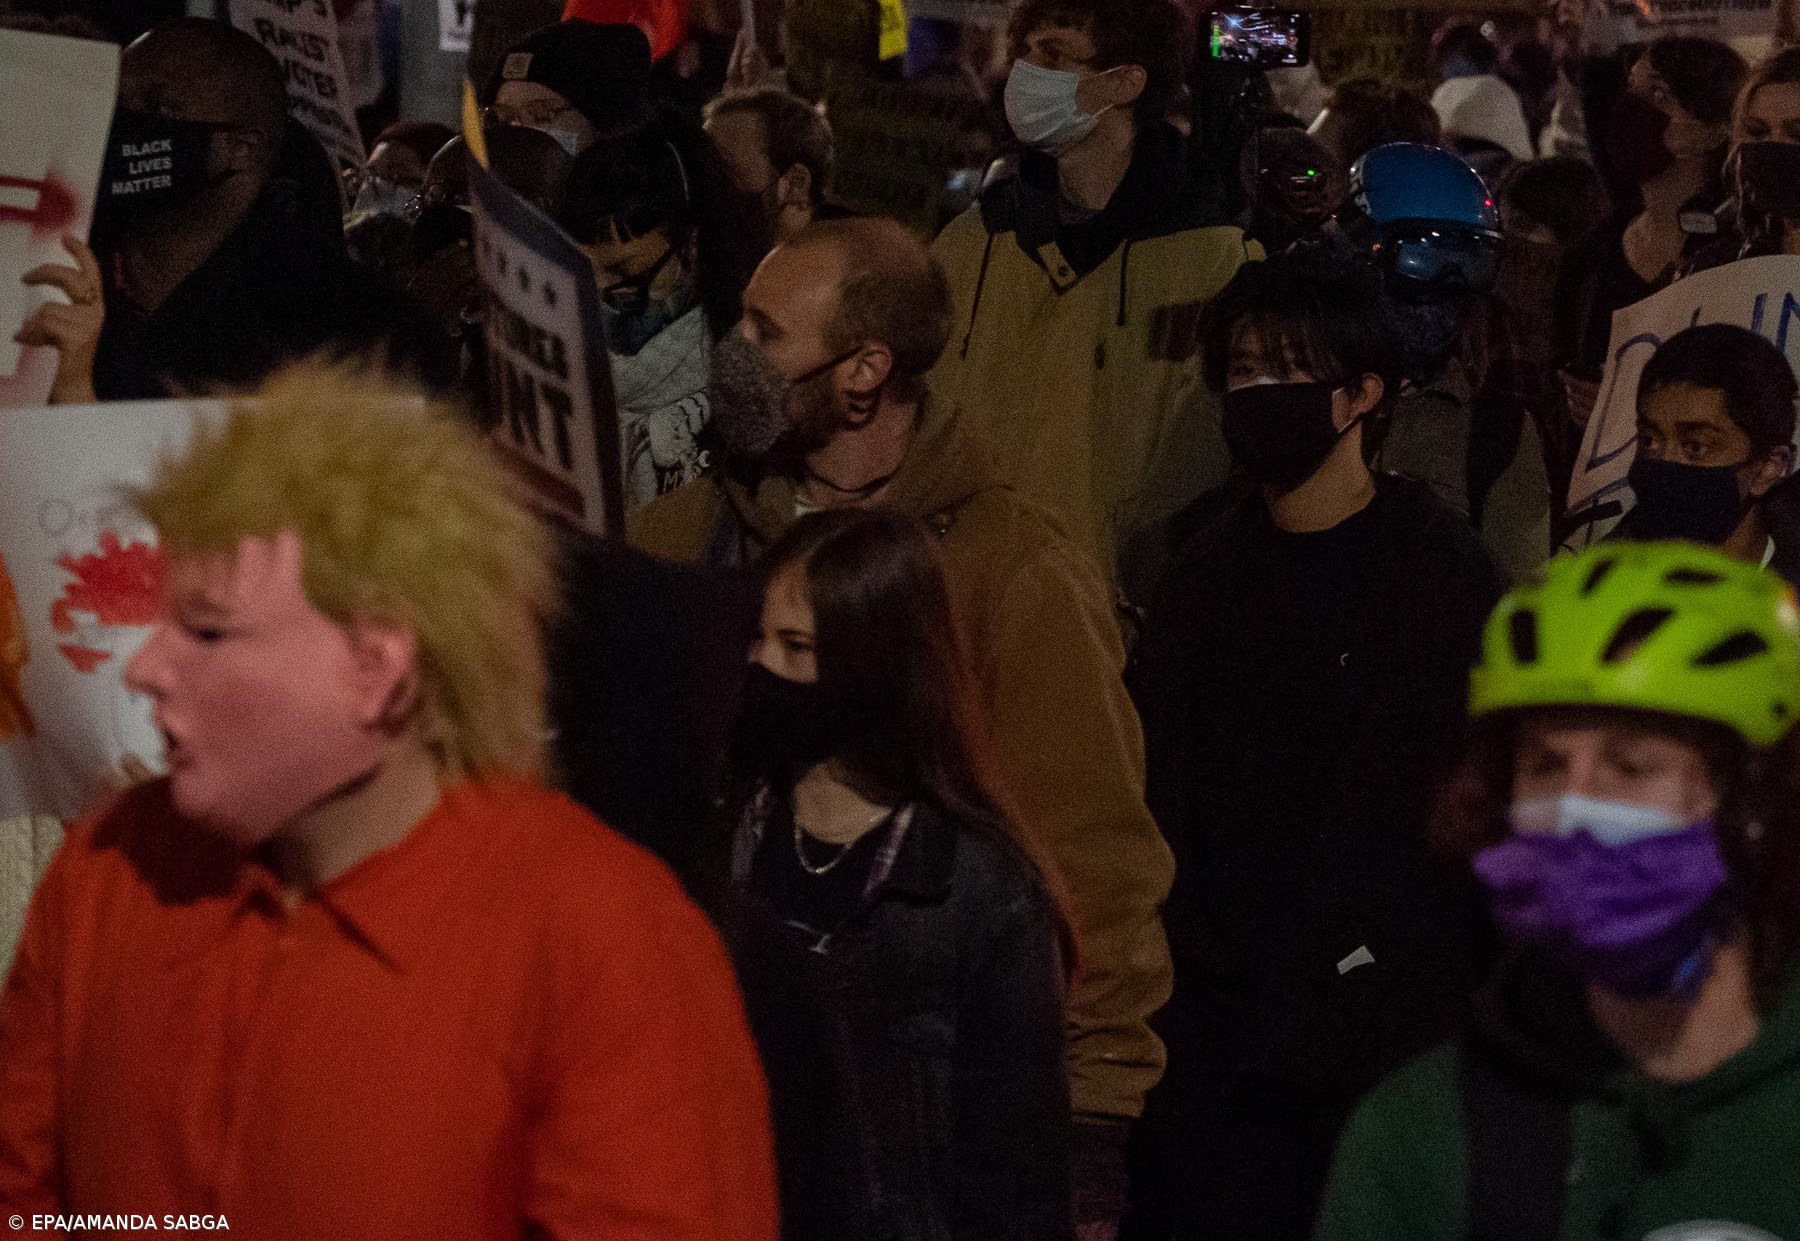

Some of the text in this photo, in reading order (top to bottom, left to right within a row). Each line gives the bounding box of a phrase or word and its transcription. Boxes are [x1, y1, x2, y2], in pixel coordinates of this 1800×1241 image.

[121, 139, 172, 157] BLACK
[128, 157, 172, 174] LIVES
[111, 174, 172, 195] MATTER
